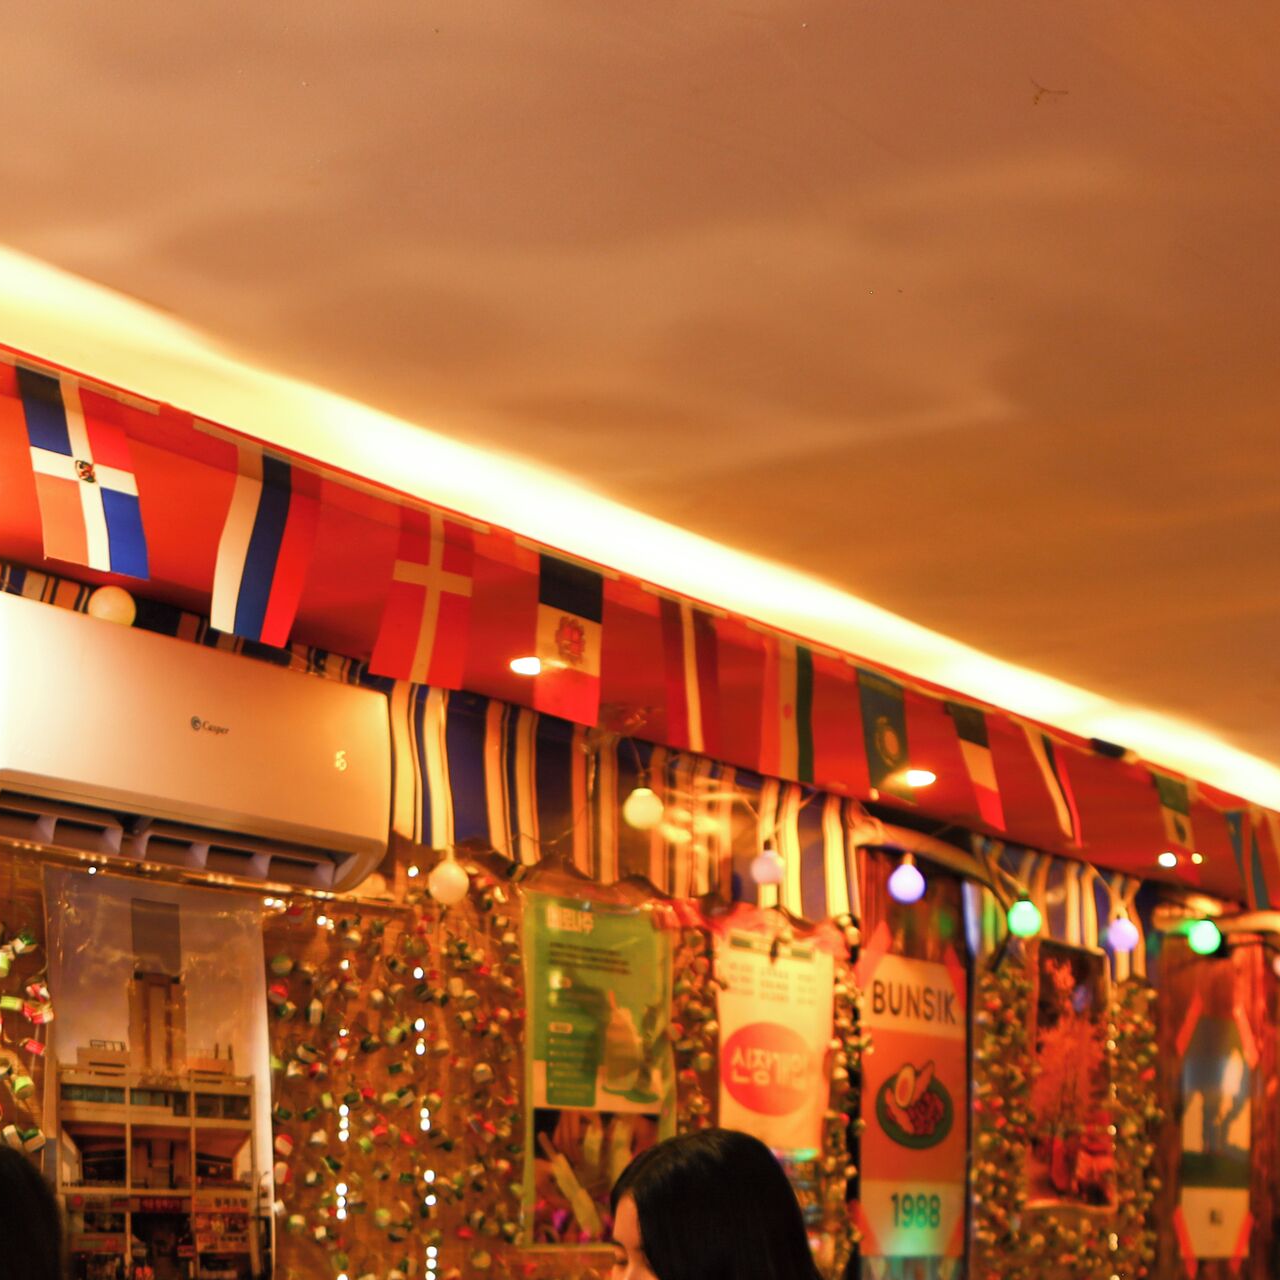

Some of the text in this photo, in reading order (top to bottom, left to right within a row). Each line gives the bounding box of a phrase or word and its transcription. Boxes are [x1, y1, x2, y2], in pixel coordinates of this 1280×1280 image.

[202, 720, 230, 735] Casper
[872, 980, 956, 1025] BUNSIK
[891, 1192, 941, 1230] 1988
